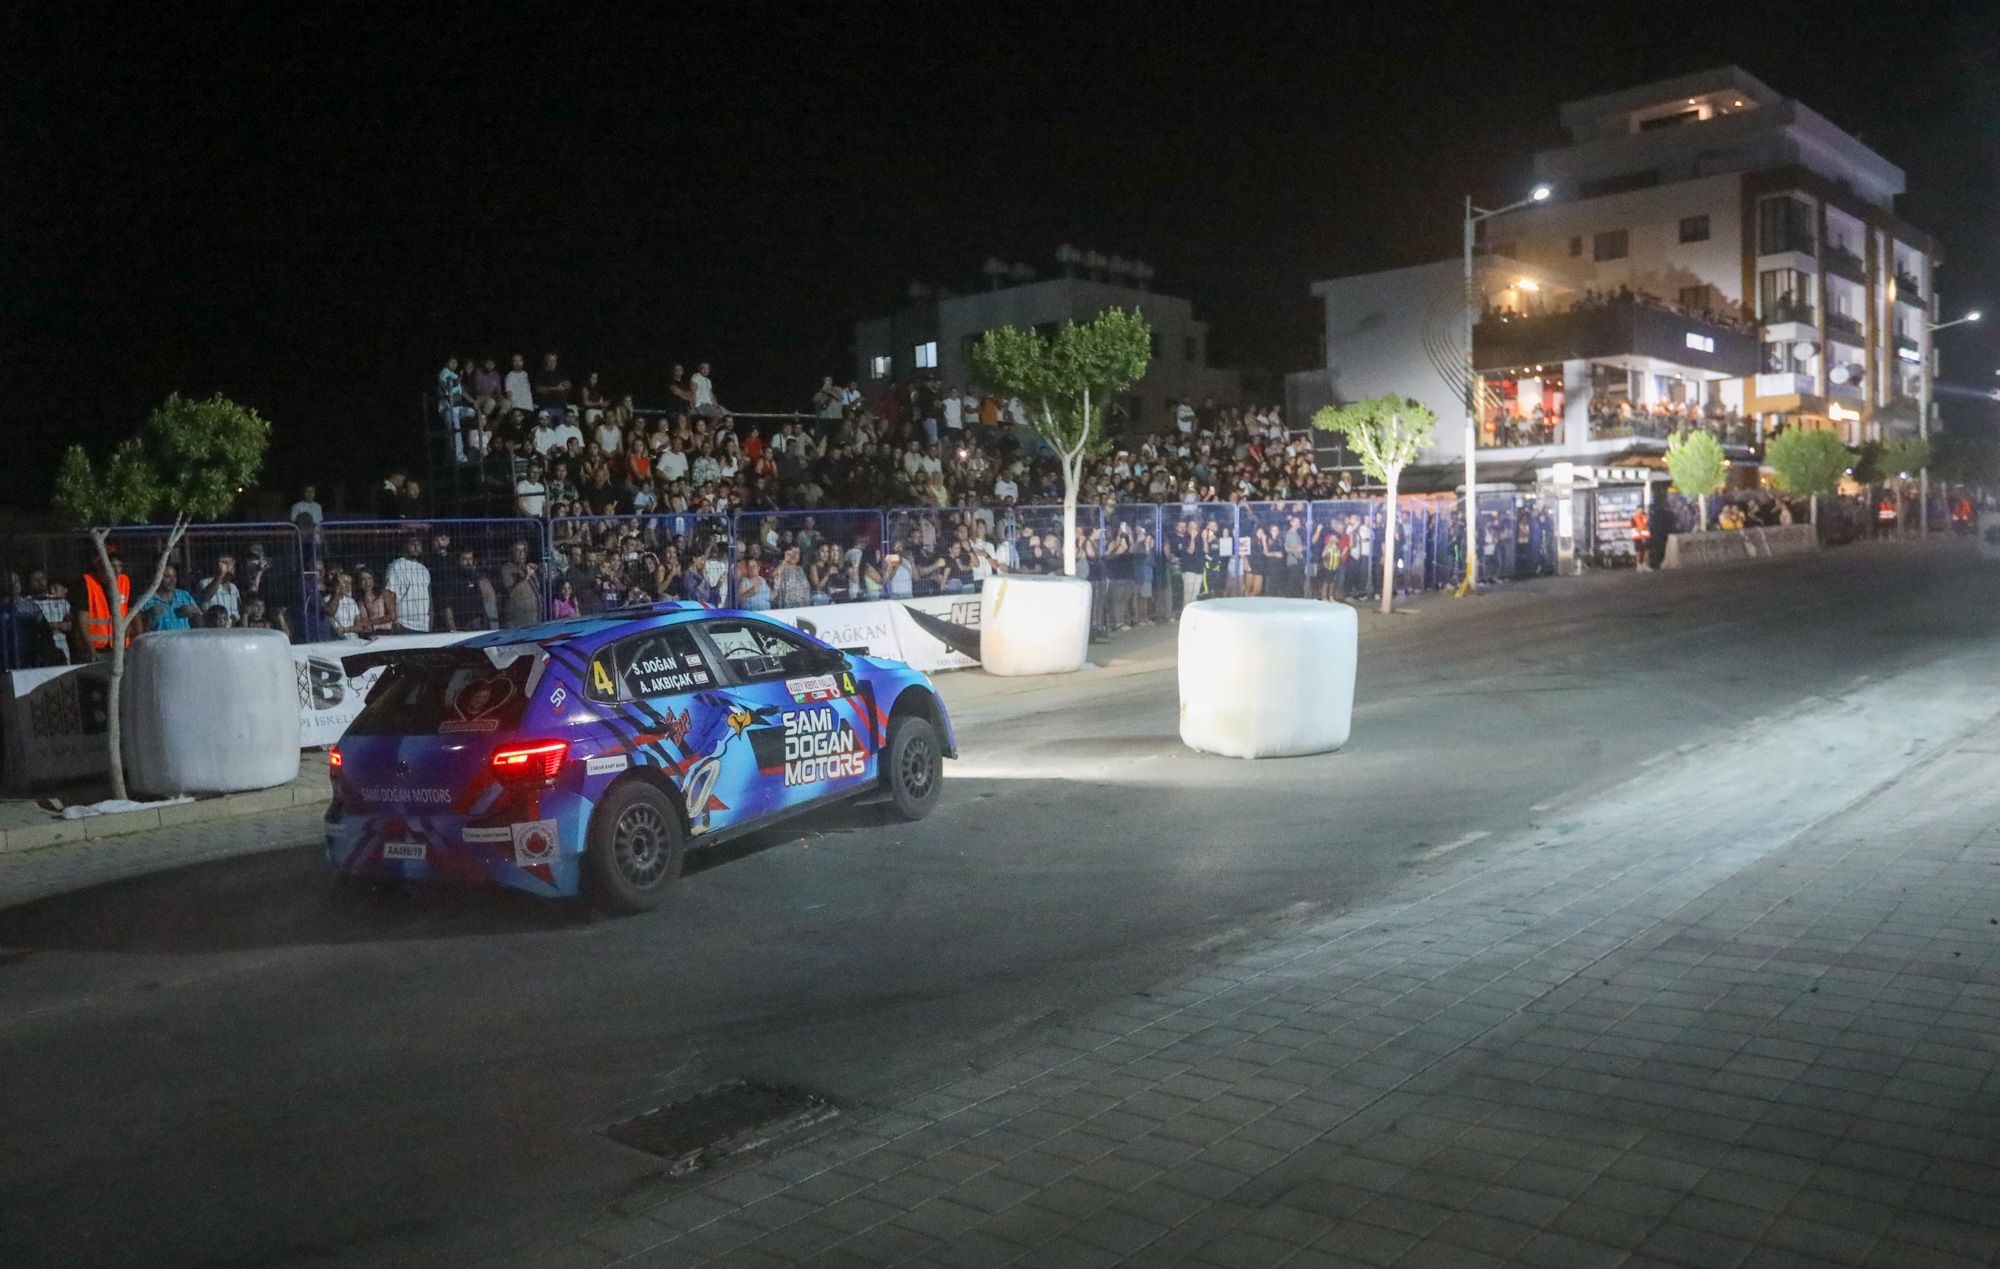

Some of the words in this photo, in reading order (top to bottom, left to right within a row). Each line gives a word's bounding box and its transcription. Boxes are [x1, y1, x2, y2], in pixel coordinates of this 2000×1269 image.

[632, 662, 644, 676] S.
[643, 656, 678, 674] DOĞAN
[593, 660, 615, 696] 4
[640, 680, 652, 694] A.
[652, 672, 694, 691] AKBIÇAK
[842, 672, 856, 695] 4
[785, 729, 853, 761] DOGAN
[785, 751, 865, 786] MOTORS
[412, 787, 452, 804] MOTORS
